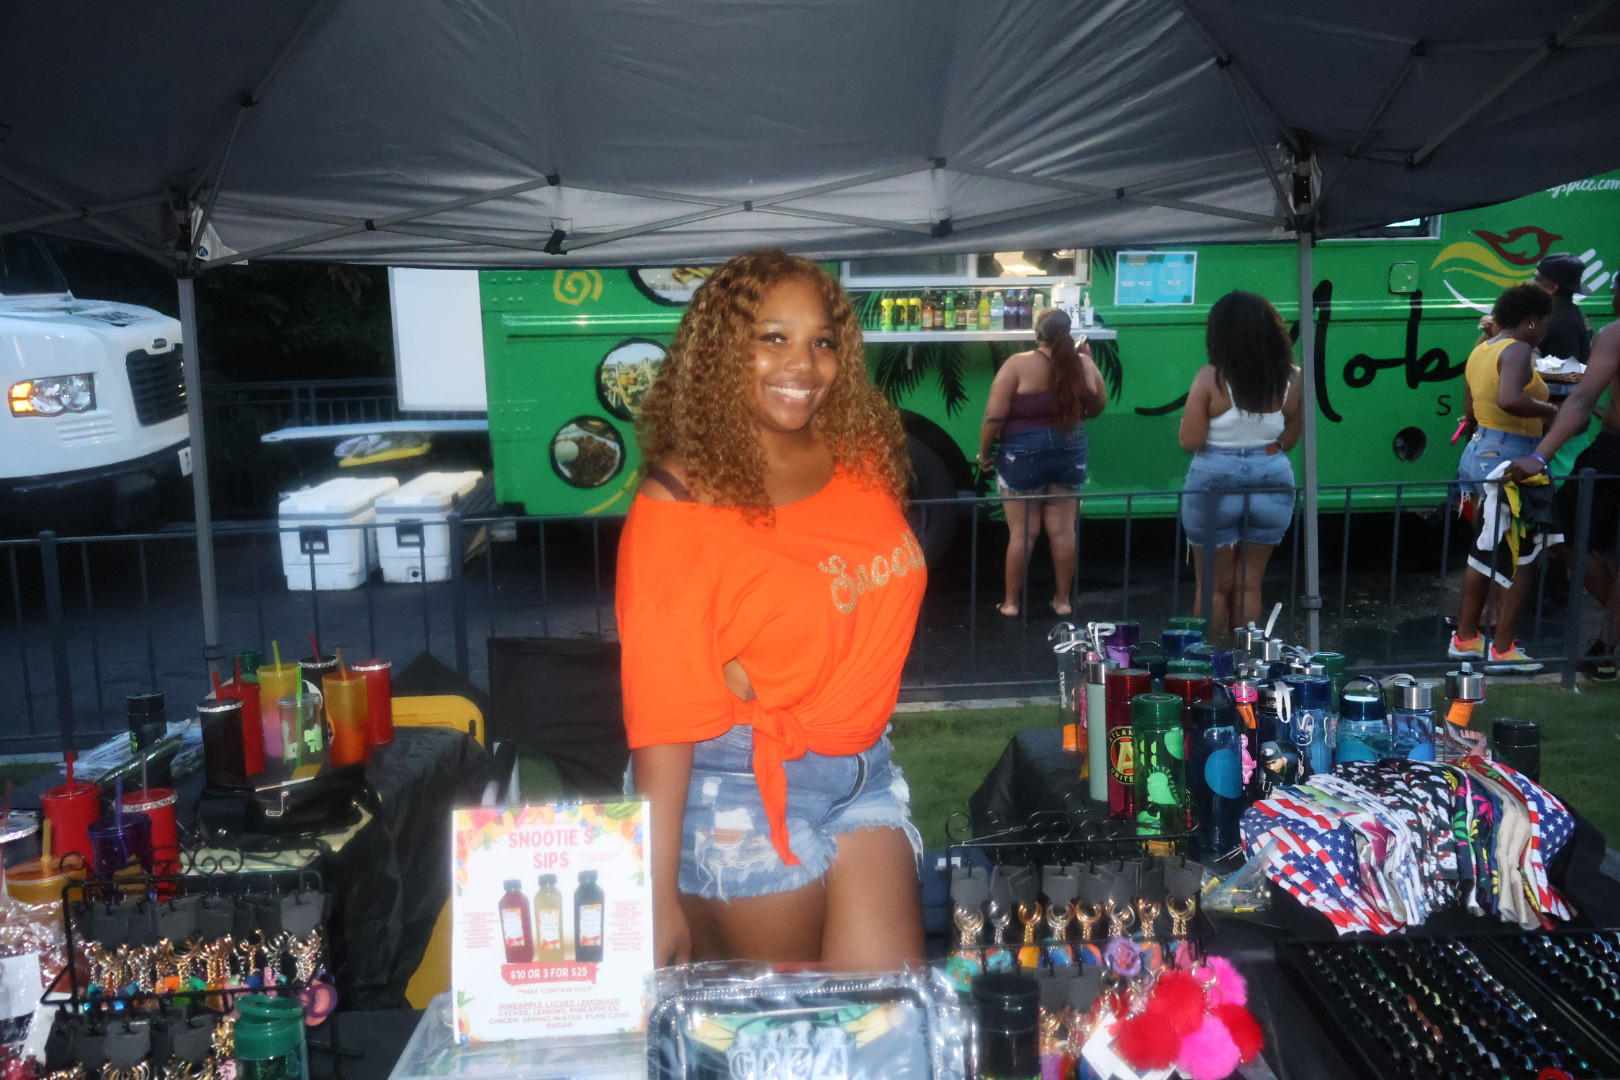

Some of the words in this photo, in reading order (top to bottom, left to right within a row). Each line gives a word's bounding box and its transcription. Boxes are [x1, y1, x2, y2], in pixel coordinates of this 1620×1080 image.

[508, 828, 594, 849] SNOOTIE'S
[533, 851, 570, 870] SIPS
[511, 969, 525, 979] $10
[528, 969, 541, 978] OR
[543, 969, 549, 978] 3
[551, 967, 569, 978] FOR
[572, 967, 588, 977] $25
[540, 986, 573, 994] CONTAIN
[545, 1000, 575, 1008] LYCHEE
[577, 998, 621, 1007] LEMONADE
[499, 1009, 532, 1017] LYCHEE,
[554, 1014, 583, 1022] WATER,
